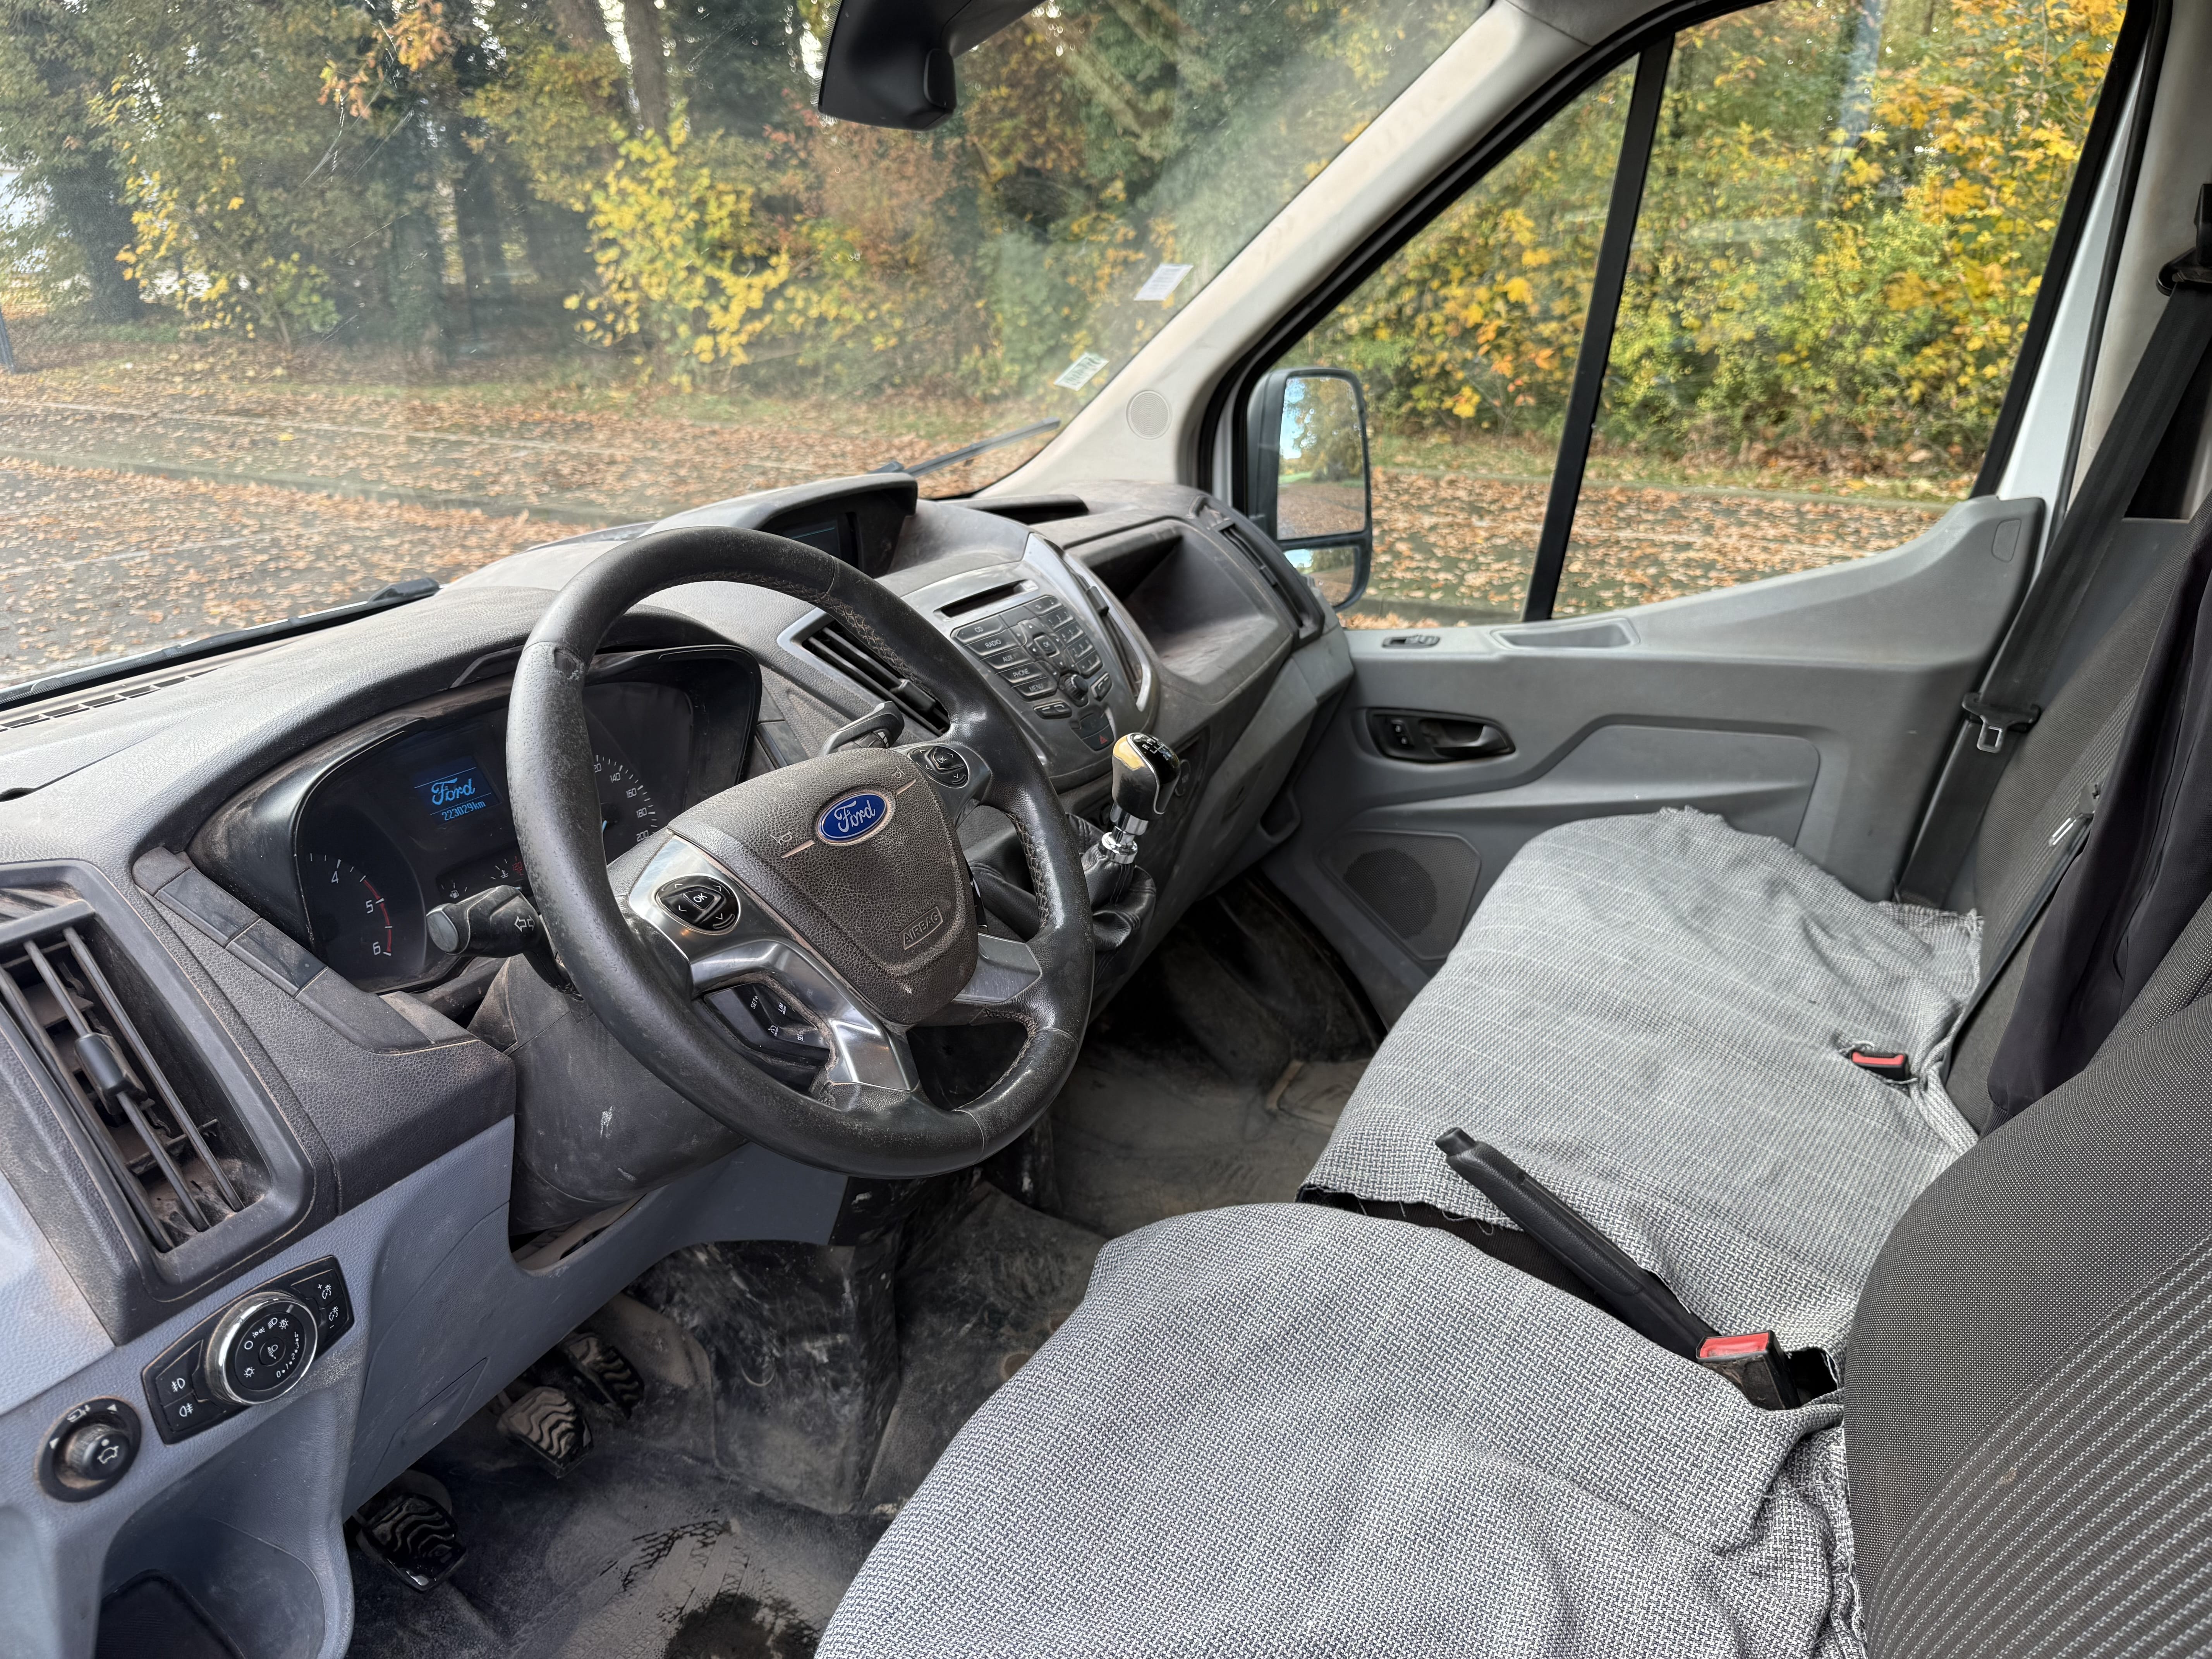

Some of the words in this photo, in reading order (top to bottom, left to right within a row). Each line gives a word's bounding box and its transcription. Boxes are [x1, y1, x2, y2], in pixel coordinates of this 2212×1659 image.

[985, 639, 1002, 648] RADIO
[1002, 654, 1013, 663] AUX
[1012, 668, 1030, 678] PHONE
[1029, 684, 1044, 692] MENU
[594, 763, 602, 773] 20
[610, 772, 621, 783] 140
[431, 777, 476, 805] Ford
[626, 788, 637, 799] 160
[636, 807, 647, 818] 180
[834, 800, 876, 833] Ford
[636, 830, 649, 842] 200
[331, 871, 339, 883] 4
[693, 893, 708, 903] OK
[366, 900, 373, 914] 5
[903, 911, 939, 945] AIRBAG
[373, 941, 381, 955] 6
[750, 995, 759, 1009] SET+
